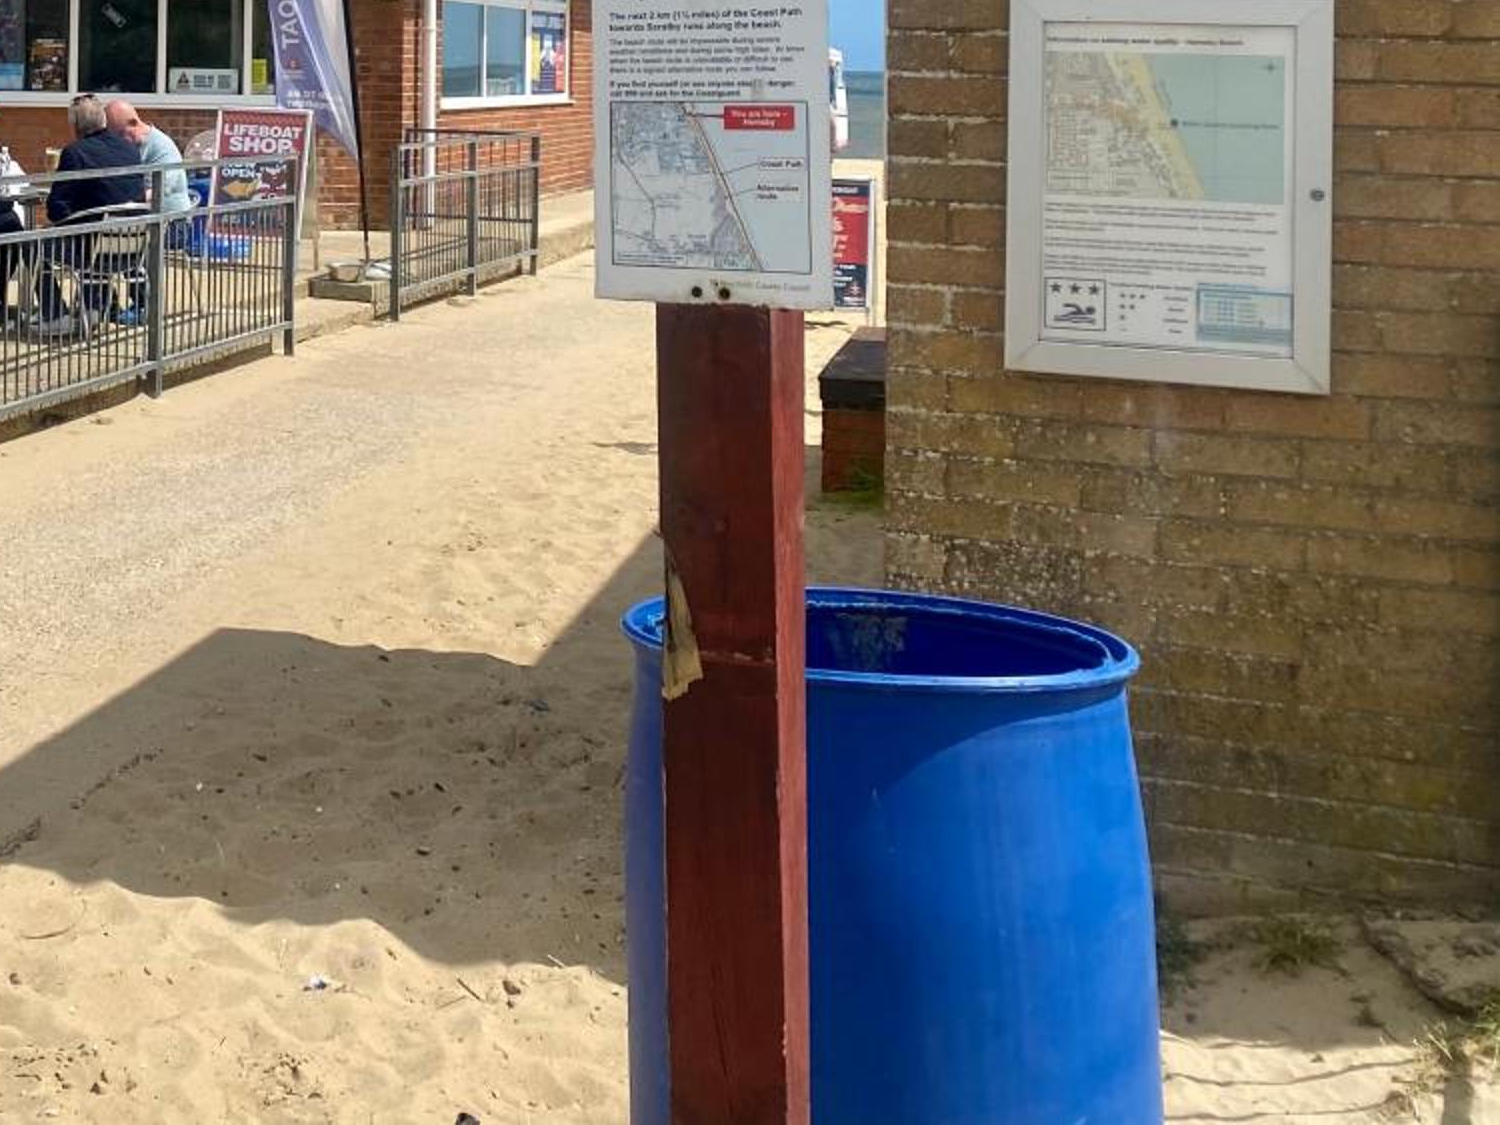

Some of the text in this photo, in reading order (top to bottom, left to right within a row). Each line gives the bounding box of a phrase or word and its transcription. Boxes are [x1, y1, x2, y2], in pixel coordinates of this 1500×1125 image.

[223, 122, 303, 138] LIFEBOAT
[229, 136, 293, 154] SHOP
[221, 167, 255, 179] OPEN
